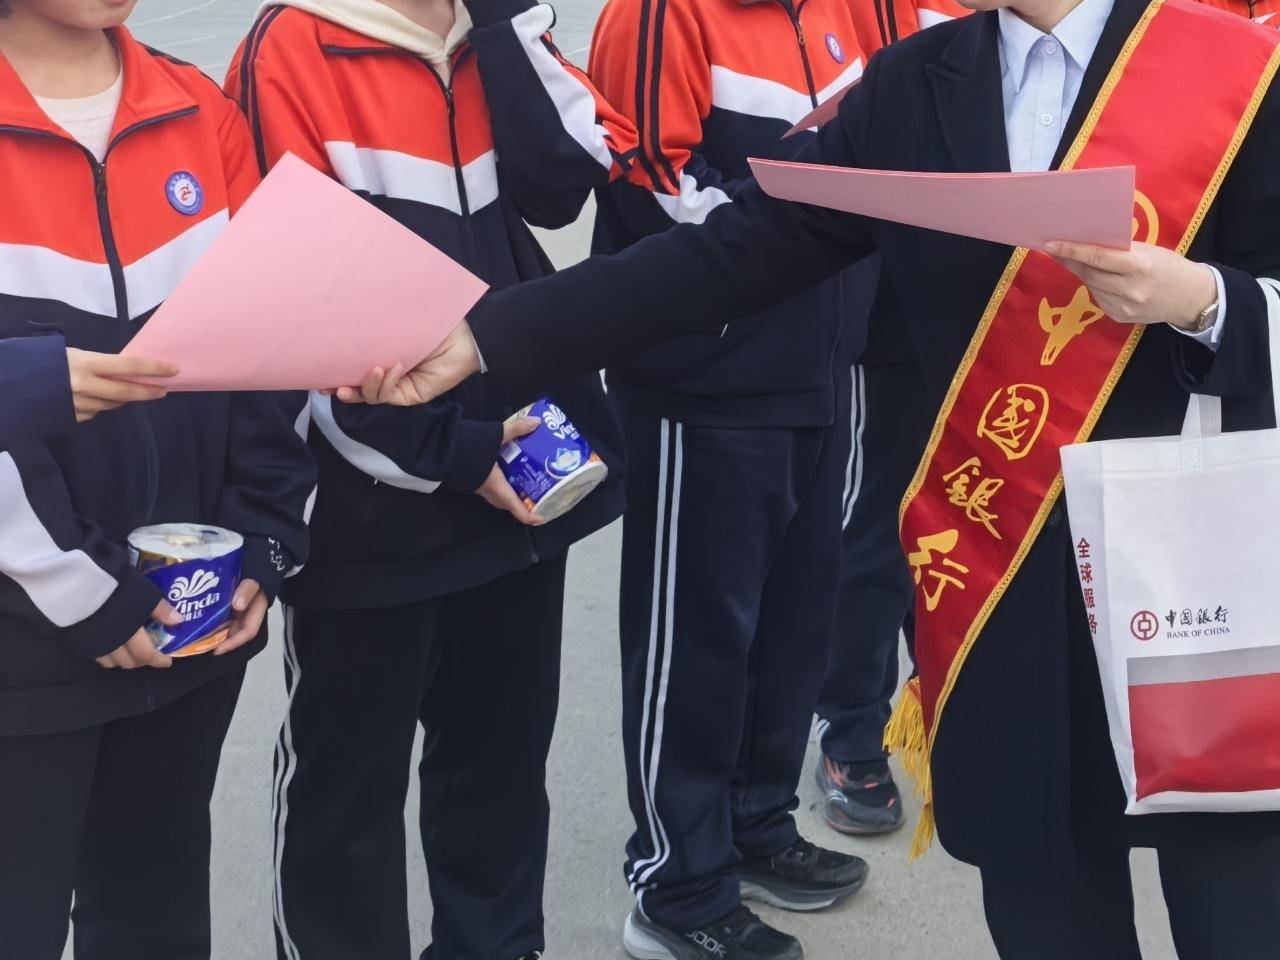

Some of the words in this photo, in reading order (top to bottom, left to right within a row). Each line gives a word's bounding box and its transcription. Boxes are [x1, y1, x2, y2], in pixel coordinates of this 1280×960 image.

[1166, 631, 1190, 639] BANK
[1191, 629, 1202, 637] OF
[1203, 627, 1230, 636] CHINA
